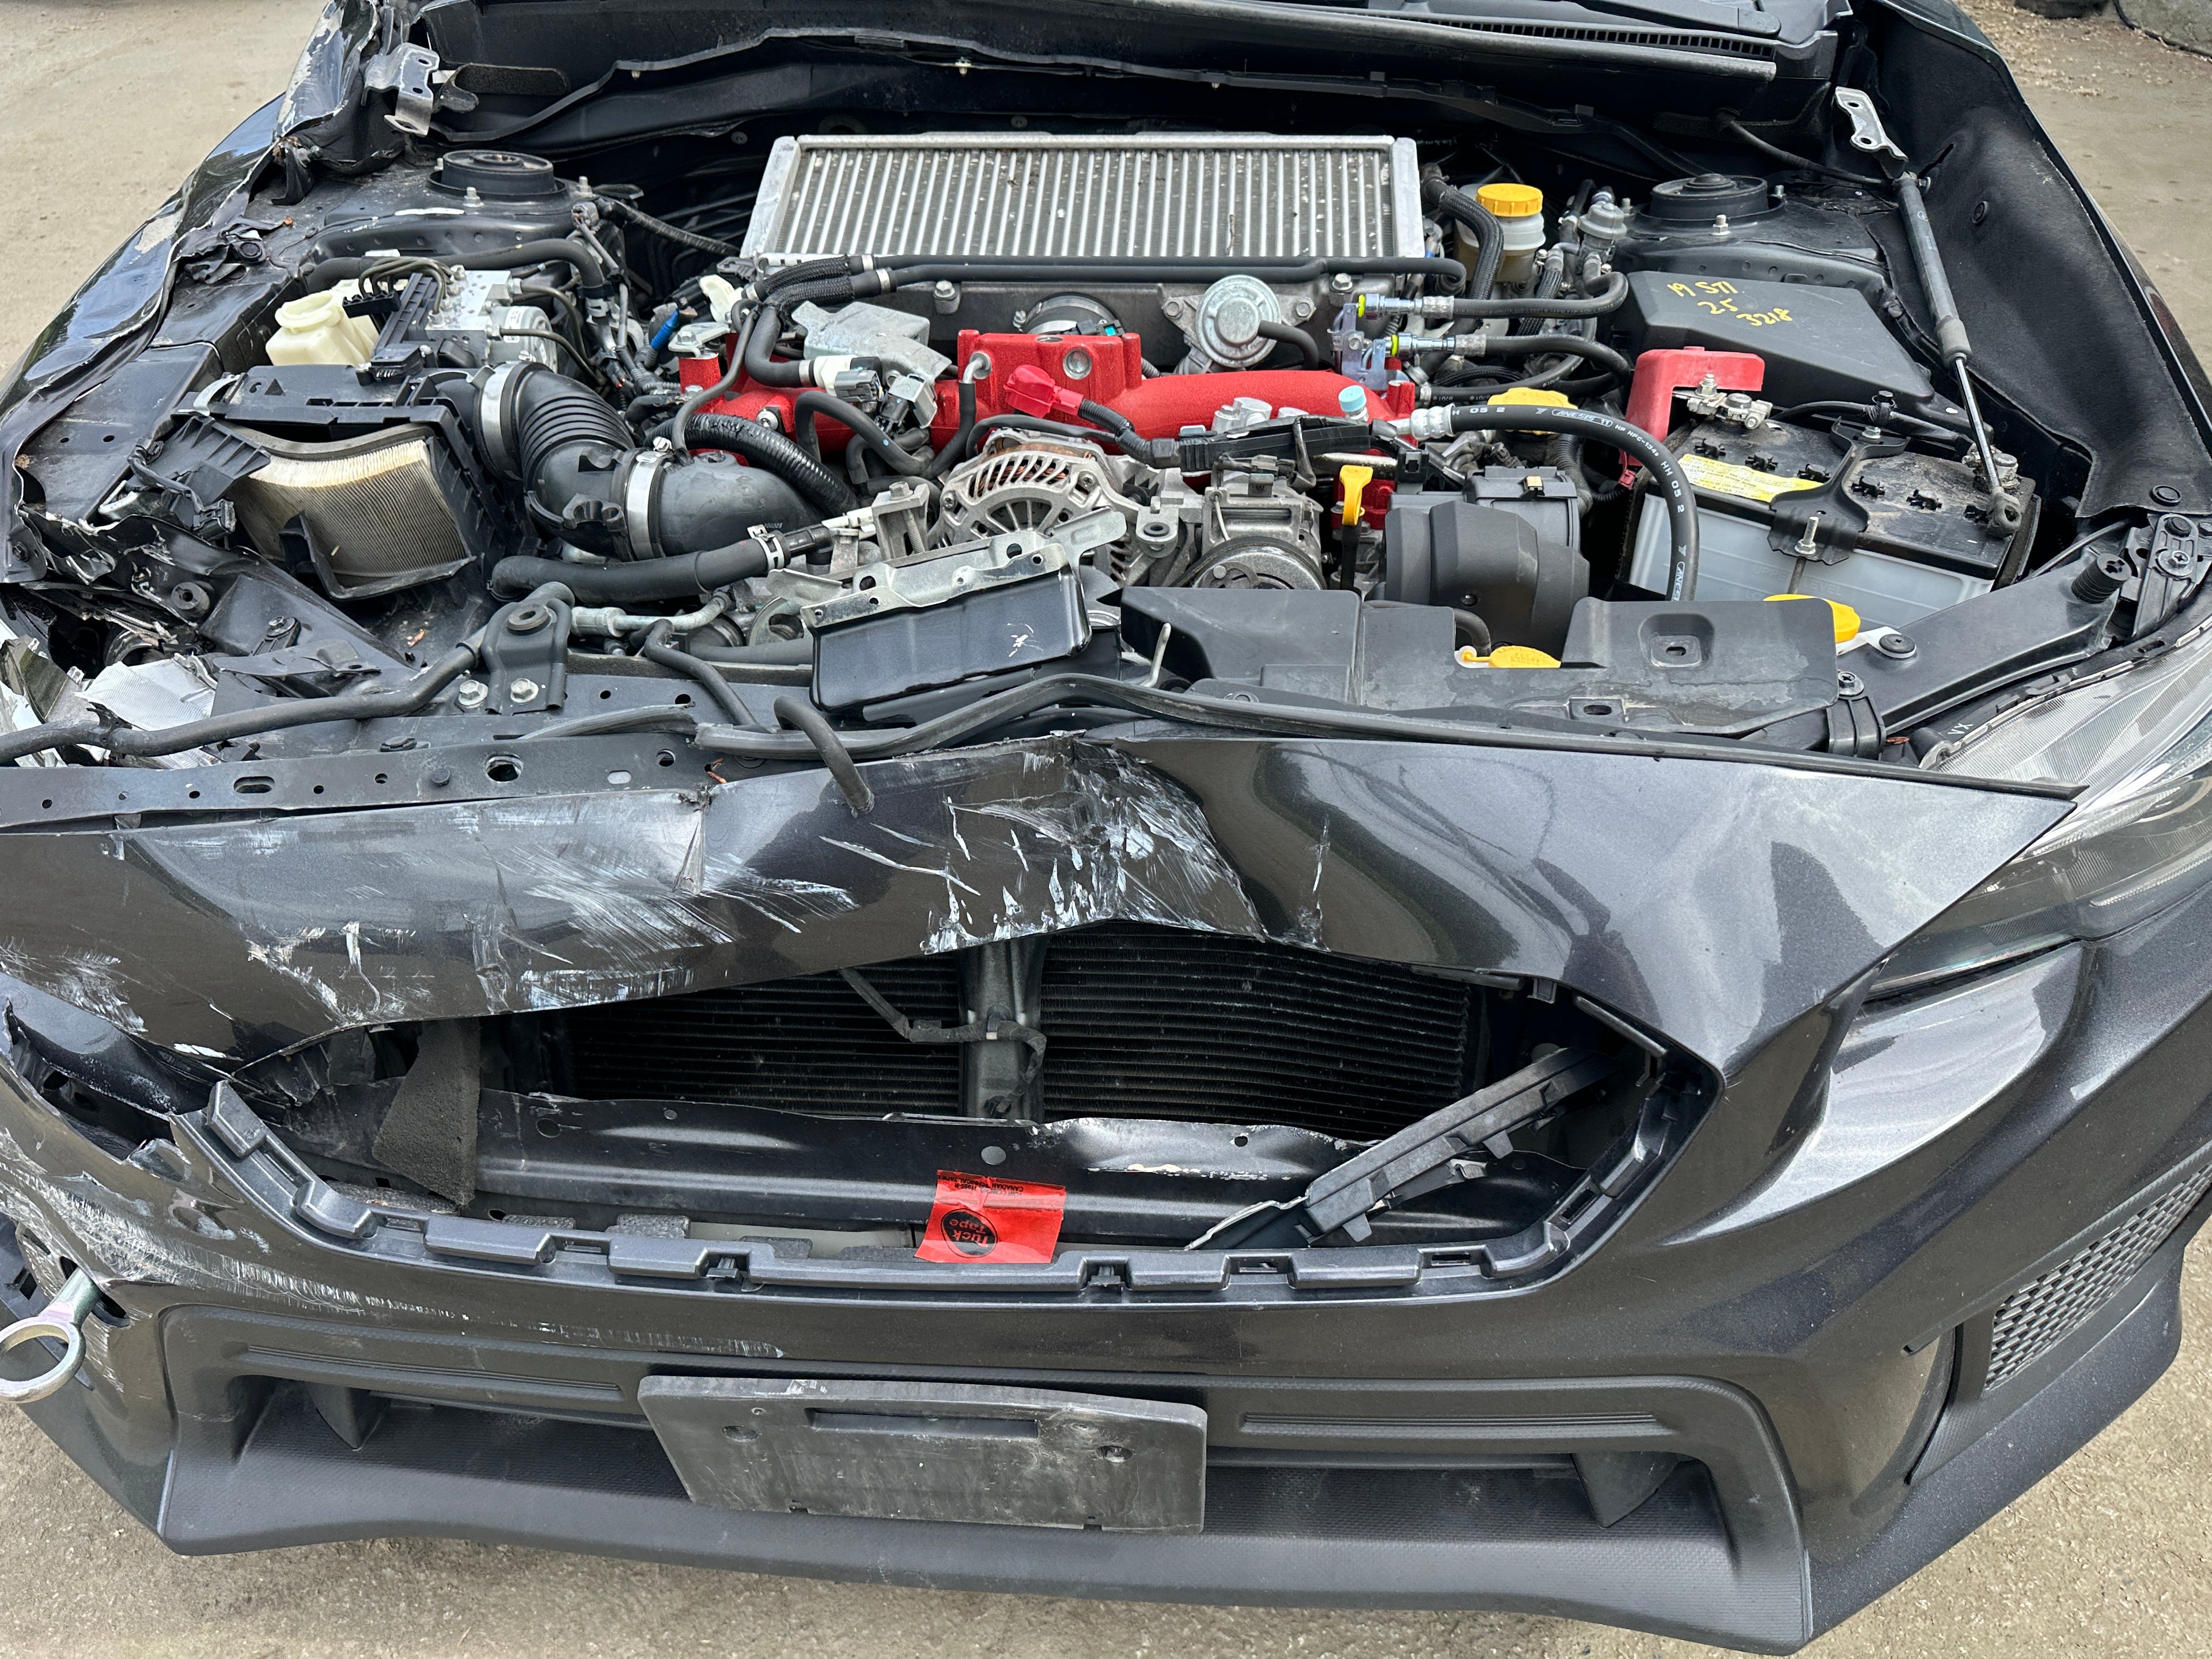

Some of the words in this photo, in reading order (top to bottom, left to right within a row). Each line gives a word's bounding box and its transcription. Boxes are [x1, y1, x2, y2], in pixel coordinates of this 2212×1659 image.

[1666, 283, 1696, 297] 19
[1695, 281, 1738, 294] STI
[1660, 461, 1673, 476] HH
[1671, 480, 1681, 497] 05
[1677, 504, 1684, 513] 2
[992, 1182, 1024, 1192] CANADIAN
[949, 1218, 986, 1234] Tape
[951, 1230, 989, 1248] Tuck
